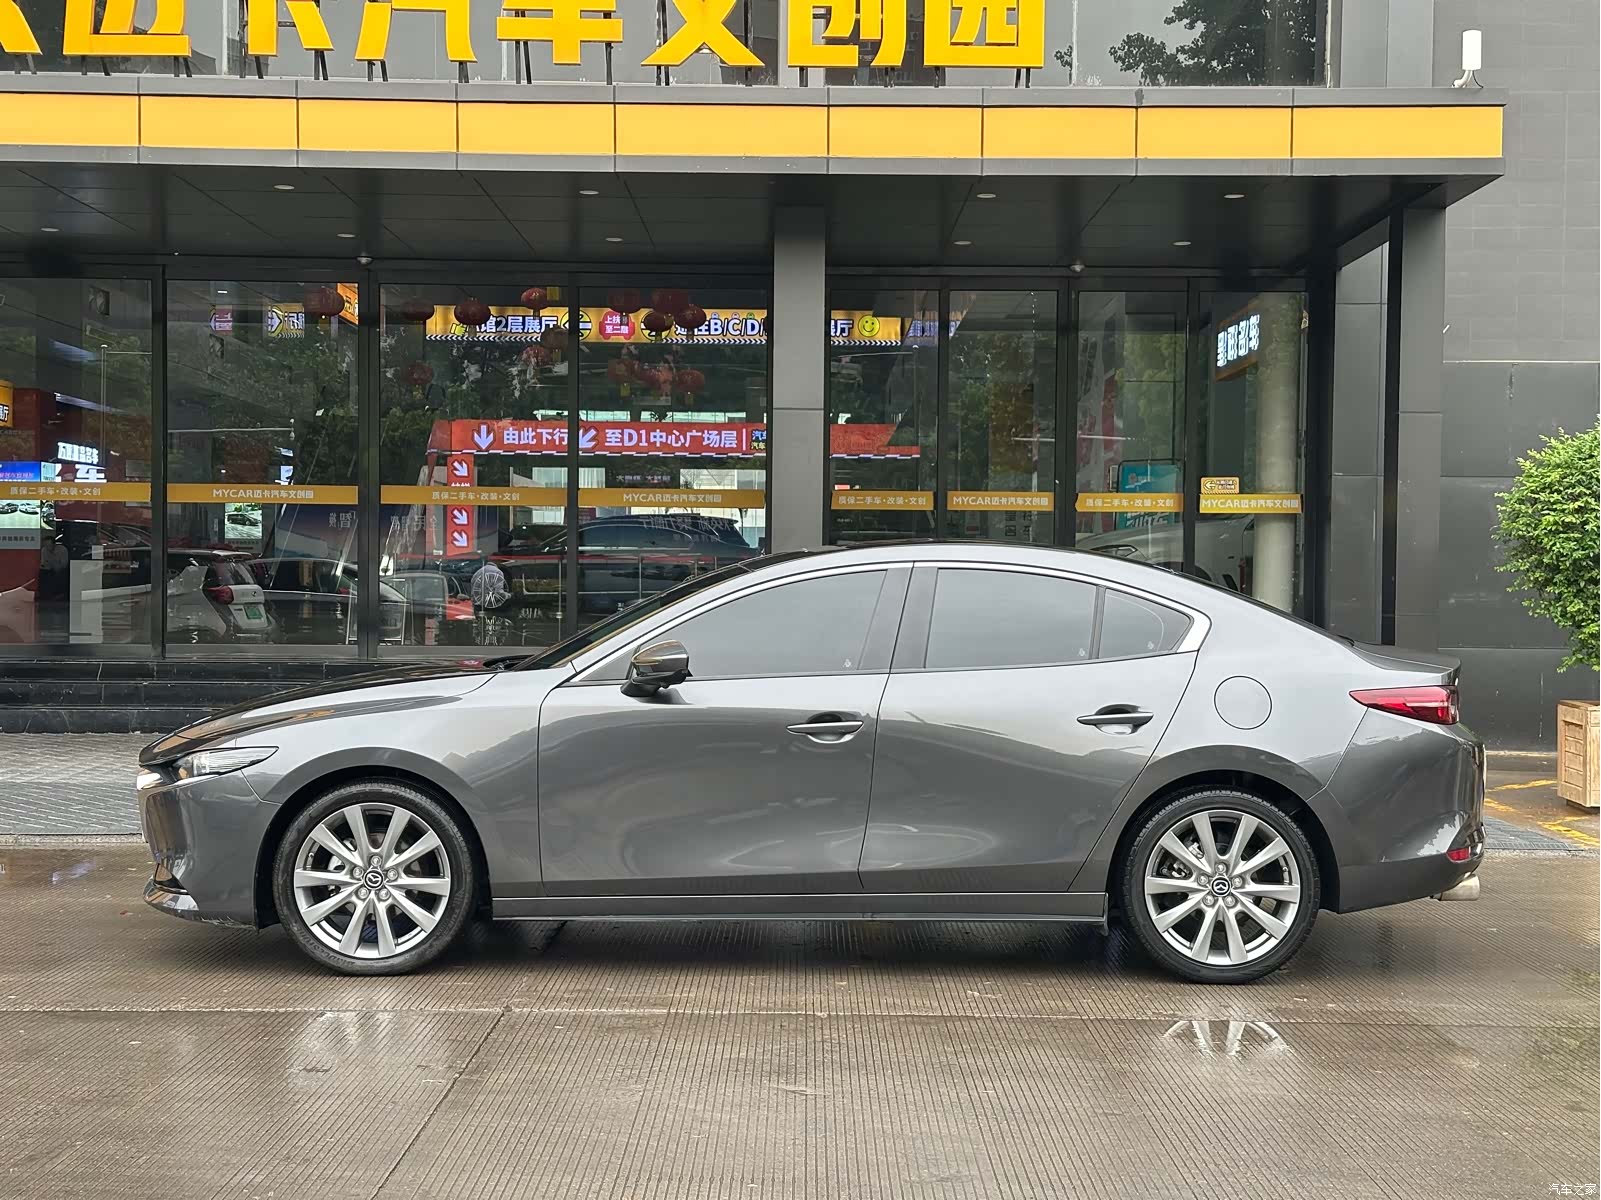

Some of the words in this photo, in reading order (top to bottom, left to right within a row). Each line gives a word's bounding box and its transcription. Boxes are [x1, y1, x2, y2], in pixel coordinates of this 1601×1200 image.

[503, 427, 569, 446] 由此下行
[604, 428, 737, 450] 至D1中心广场层
